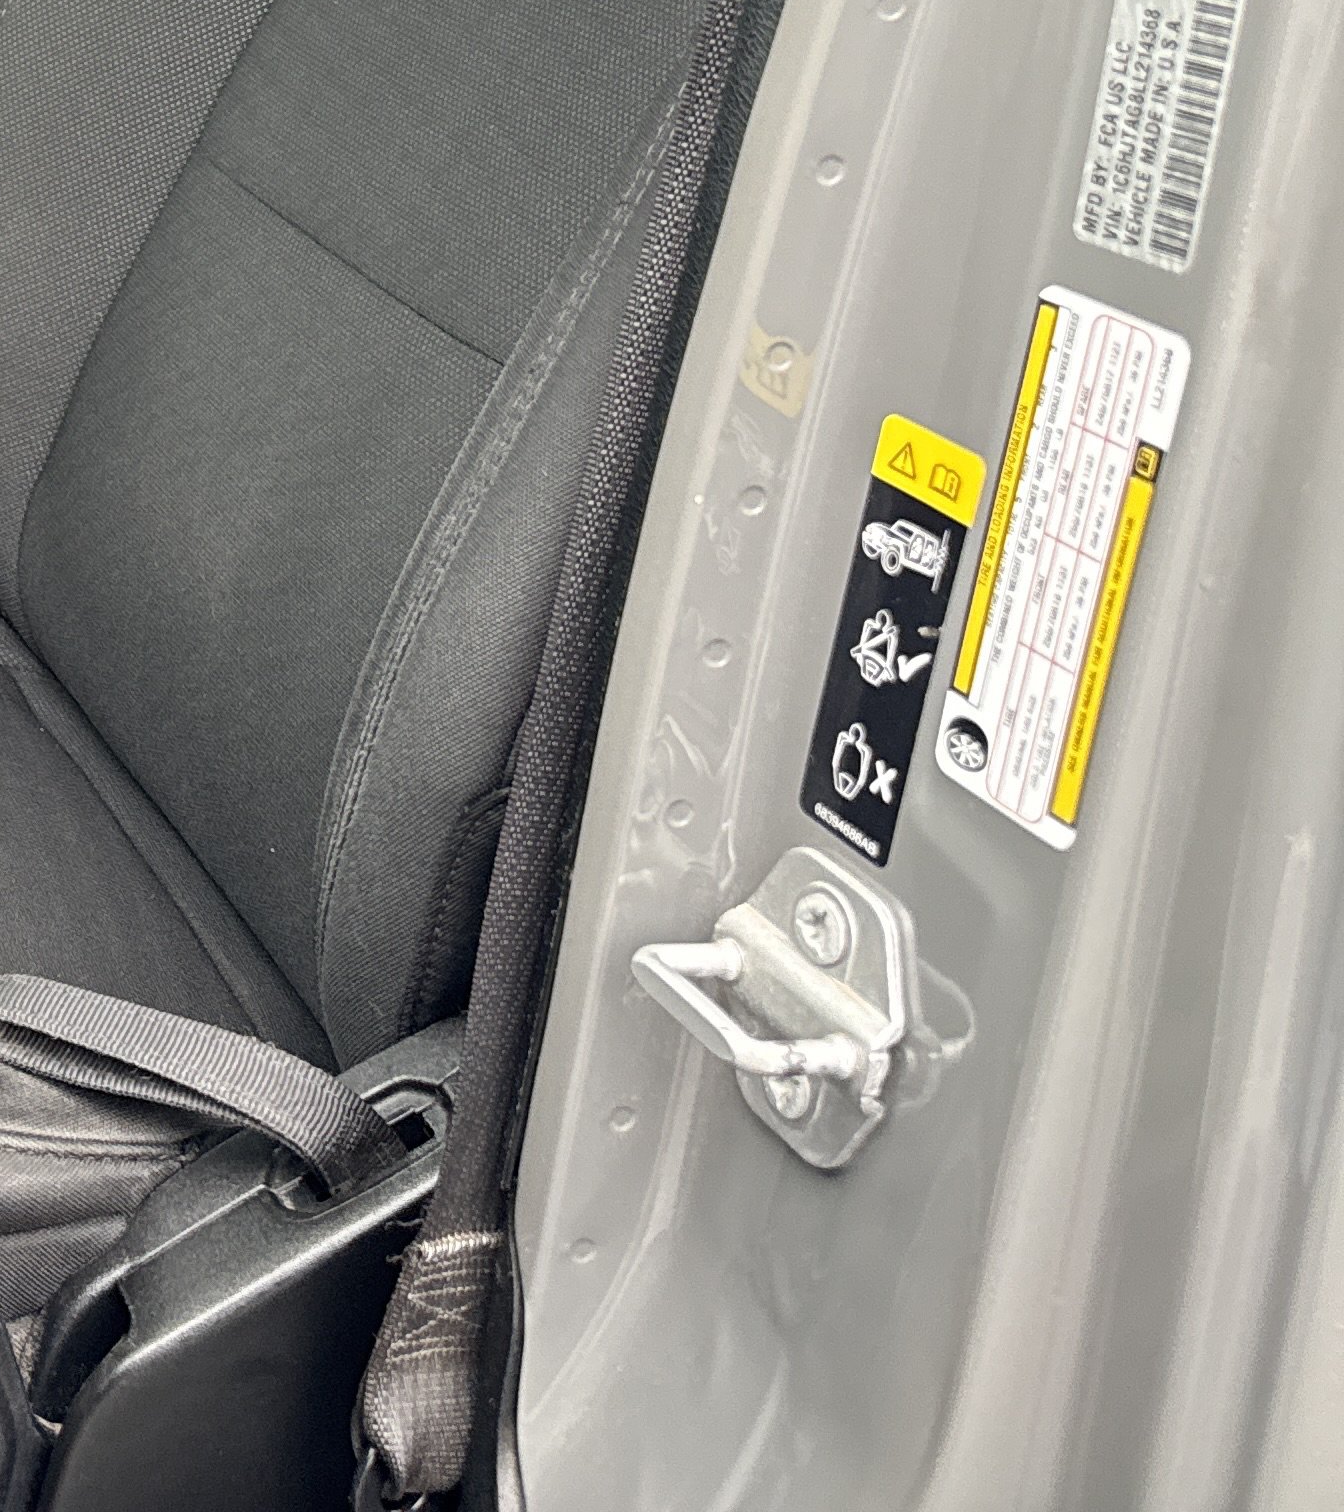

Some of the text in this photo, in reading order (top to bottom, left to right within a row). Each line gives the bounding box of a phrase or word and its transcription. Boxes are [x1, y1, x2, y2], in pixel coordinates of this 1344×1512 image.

[1111, 39, 1133, 76] LLC
[1105, 78, 1125, 106] US
[1150, 76, 1170, 105] IN:
[1097, 110, 1118, 148] FCA
[1139, 109, 1164, 166] MADE
[1081, 191, 1102, 234] MFD
[1123, 168, 1152, 249] VEHICLE
[978, 402, 1028, 587] TIRE AND LOADING INFORMATION
[990, 312, 1080, 664] THE COMBINED WEIGHT OF OCCUPANTS AND CARGO SHOULD NEVER EXCEED
[1031, 572, 1045, 605] FRONT
[1057, 467, 1070, 495] REAR
[1076, 384, 1090, 416] SPARE
